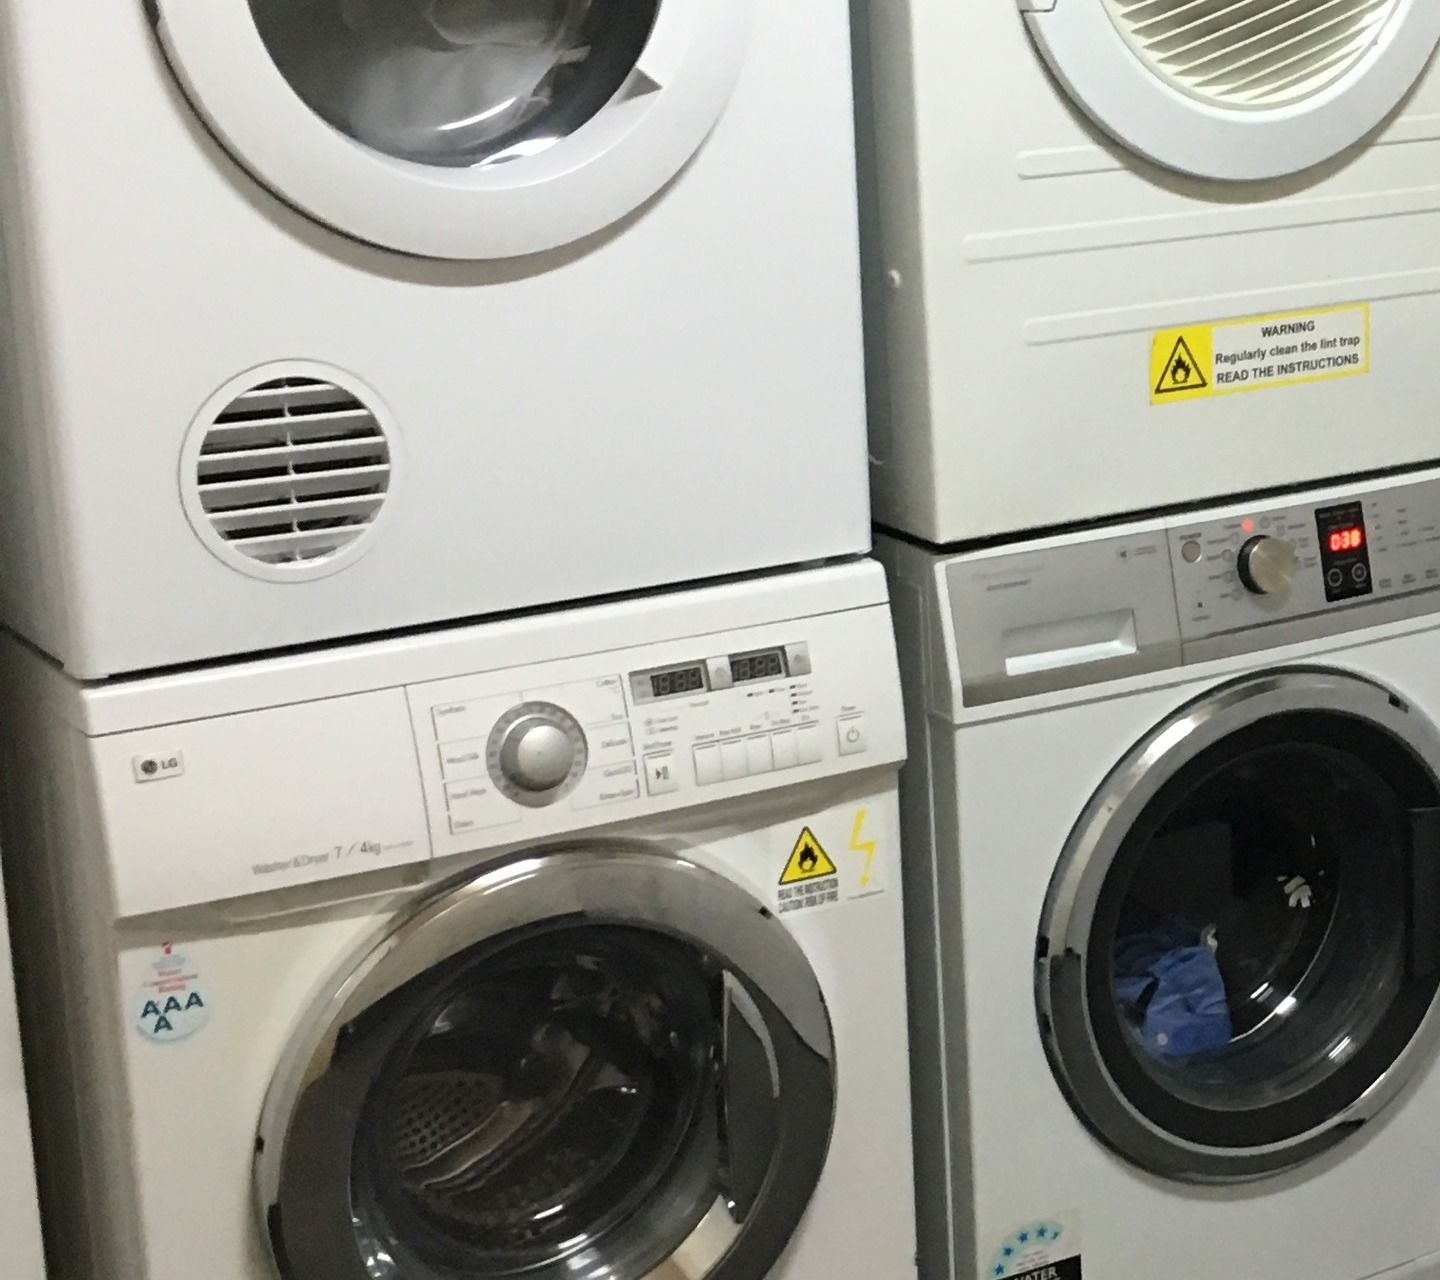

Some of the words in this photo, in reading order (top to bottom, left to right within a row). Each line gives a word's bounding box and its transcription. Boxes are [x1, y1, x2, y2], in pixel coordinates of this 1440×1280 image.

[1261, 320, 1315, 338] WARNING
[1215, 349, 1266, 366] Regularly
[1269, 344, 1298, 357] clean
[1300, 340, 1318, 352] the
[1320, 337, 1337, 350] lint
[1339, 336, 1361, 349] trap
[1216, 370, 1249, 385] READ
[1252, 366, 1275, 380] THE
[1277, 353, 1359, 376] INSTRUCTIONS
[161, 757, 178, 771] LG
[335, 846, 343, 859] 7
[360, 841, 381, 855] 4kg
[153, 1014, 174, 1033] A
